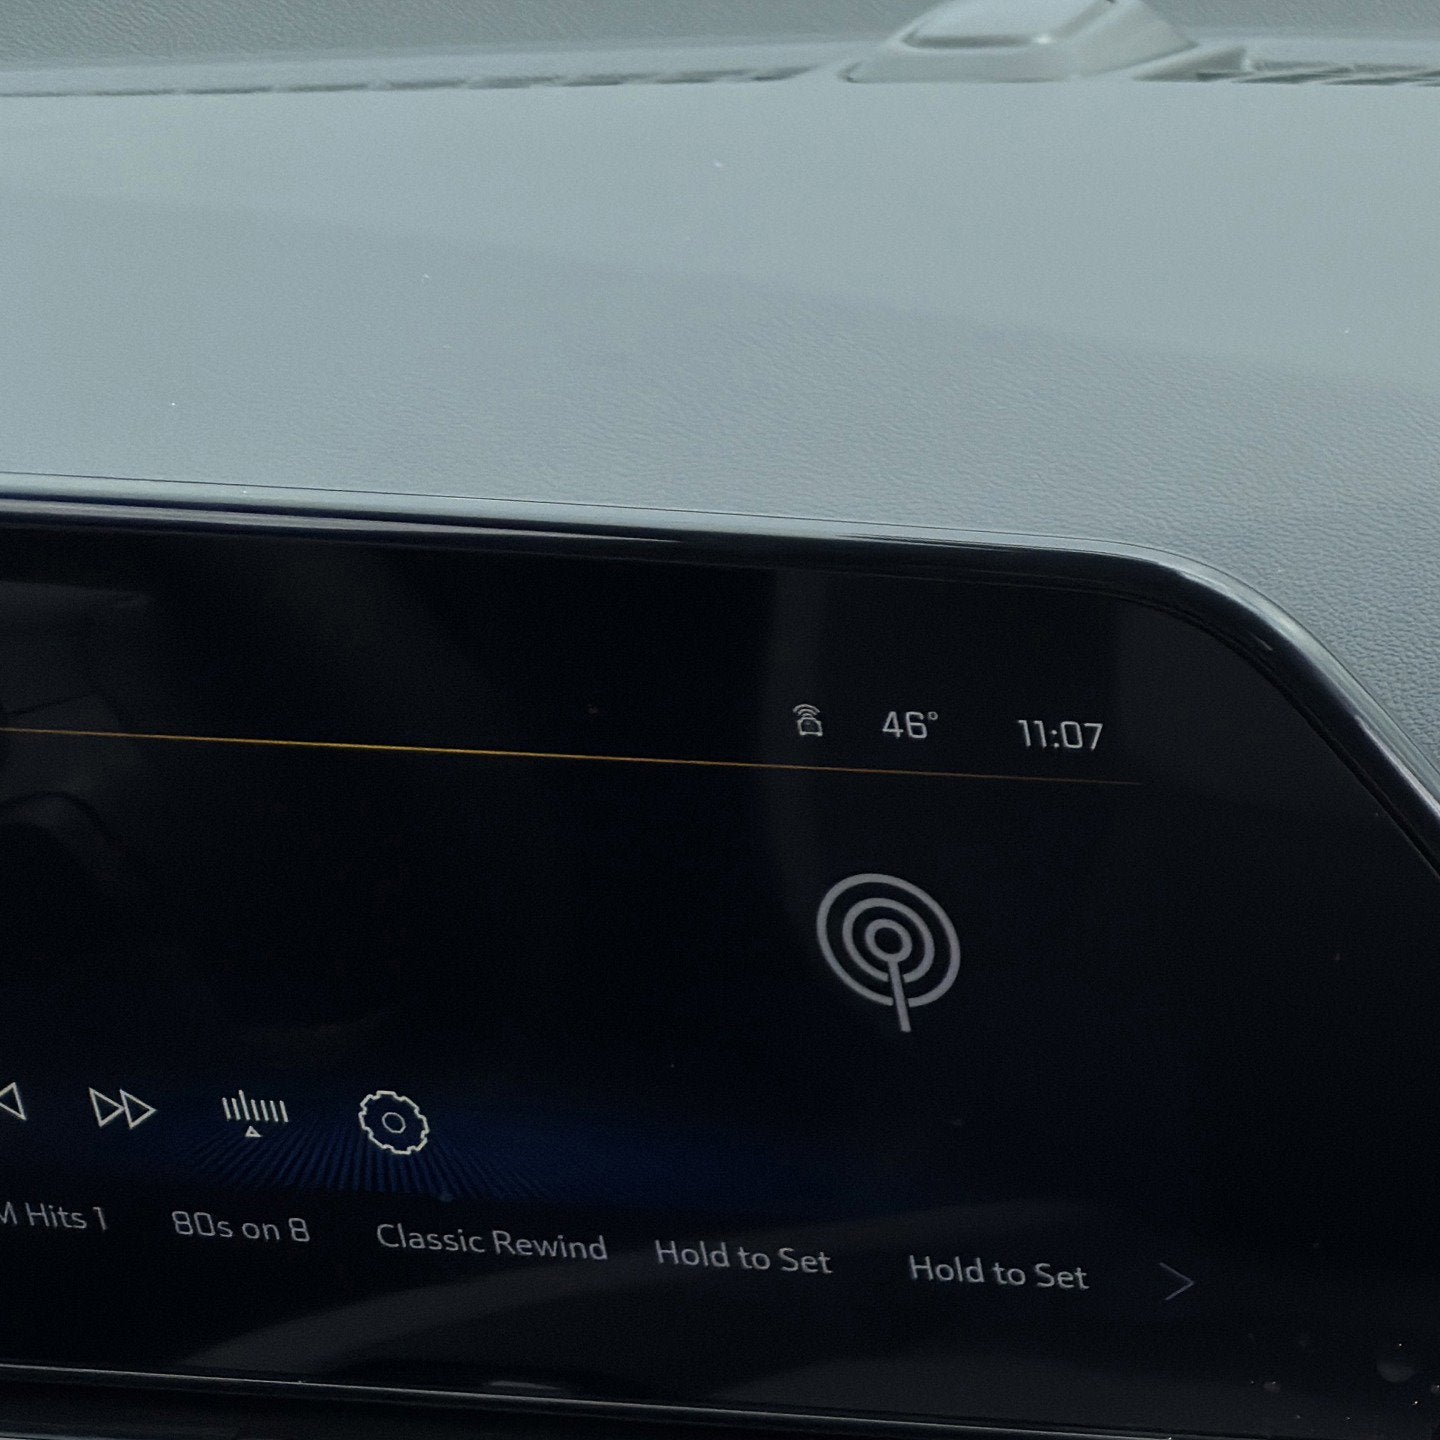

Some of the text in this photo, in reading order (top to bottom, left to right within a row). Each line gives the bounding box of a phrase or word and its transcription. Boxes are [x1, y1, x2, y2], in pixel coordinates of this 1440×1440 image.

[1018, 720, 1103, 750] 11:07
[25, 1203, 87, 1228] Hits
[93, 1207, 106, 1230] 1
[172, 1211, 310, 1241] 80s on 8
[377, 1223, 608, 1260] Classic Rewind
[655, 1240, 832, 1273] Hold to Set
[910, 1255, 1089, 1289] Hold to Set
